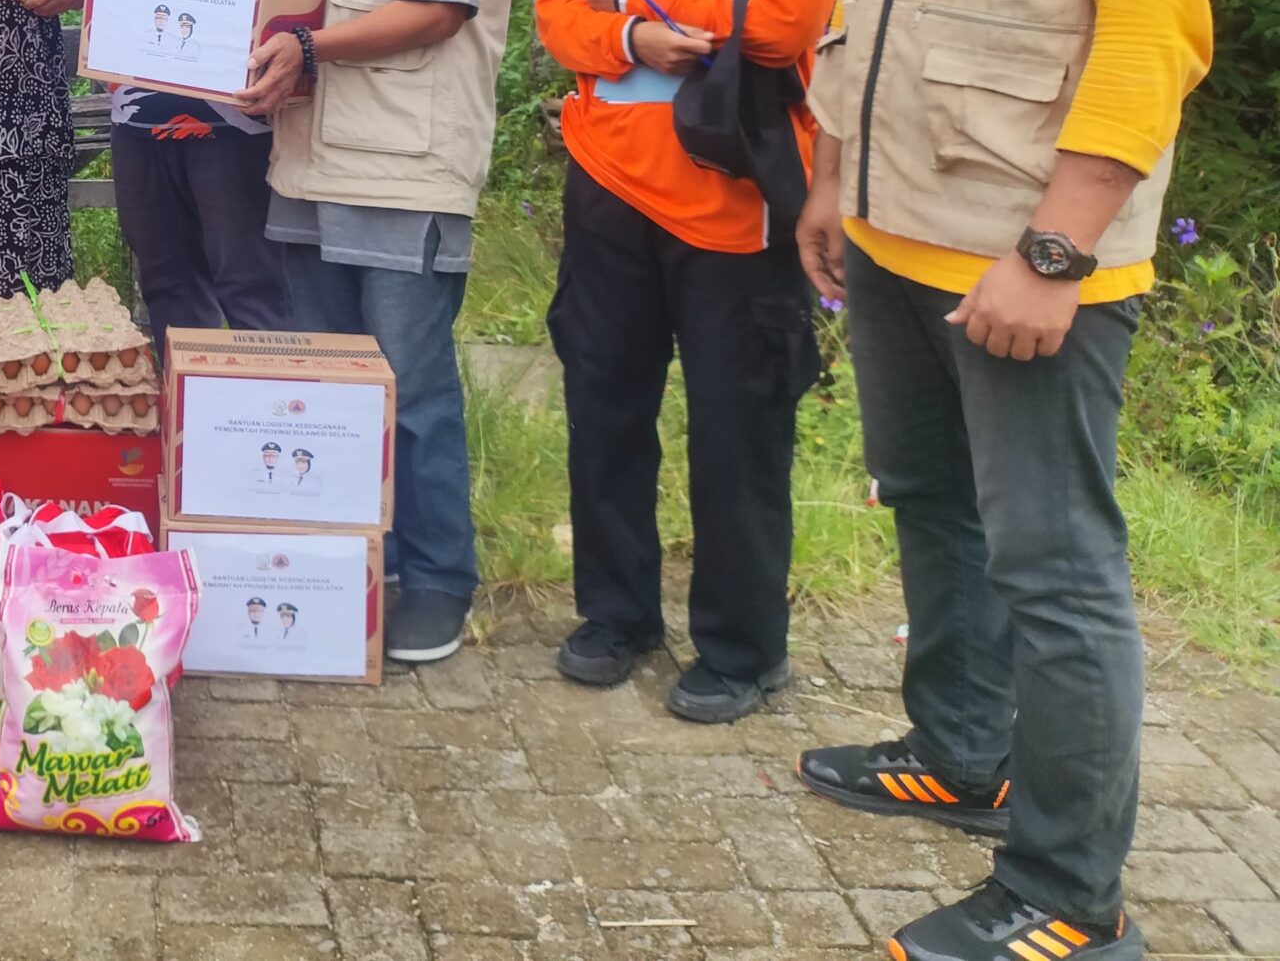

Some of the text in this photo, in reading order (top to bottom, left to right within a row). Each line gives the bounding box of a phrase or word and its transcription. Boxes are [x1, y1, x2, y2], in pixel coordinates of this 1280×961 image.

[214, 426, 258, 434] PEMERINTAH
[228, 419, 260, 427] BANTUAN
[45, 599, 129, 617] Beras Kepala
[16, 739, 135, 776] Mawar
[42, 764, 150, 803] Melati
